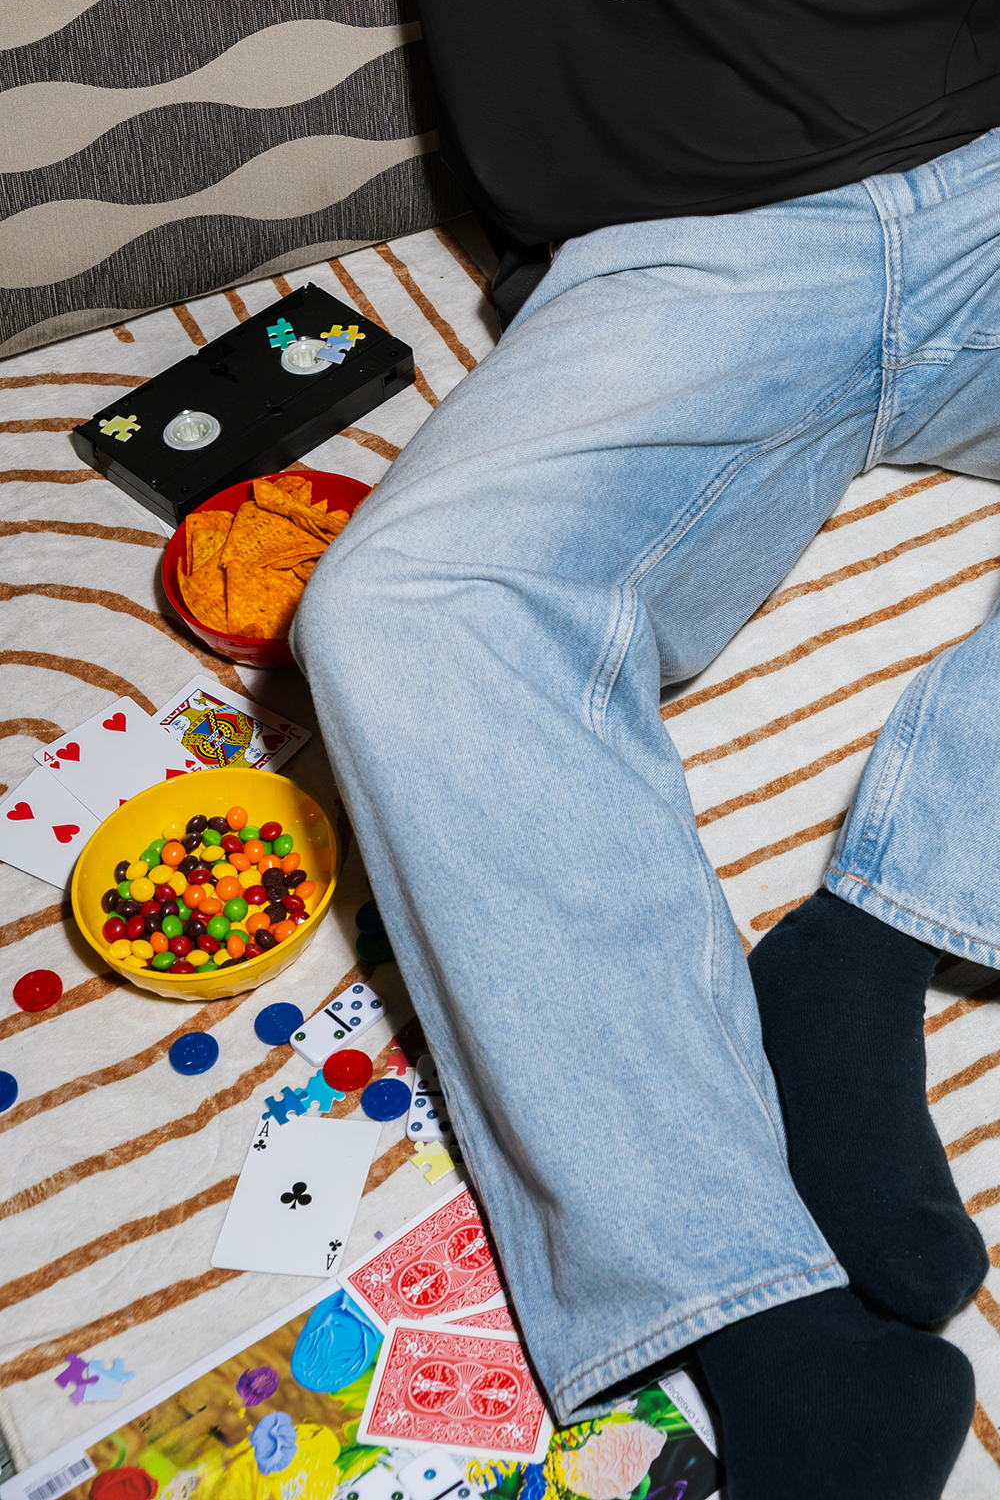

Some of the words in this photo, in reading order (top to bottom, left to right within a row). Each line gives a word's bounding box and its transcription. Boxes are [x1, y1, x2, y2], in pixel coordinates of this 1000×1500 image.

[43, 751, 55, 763] 4
[258, 1121, 270, 1138] A
[325, 1253, 338, 1271] A
[660, 1377, 697, 1421] TERIORISMO
